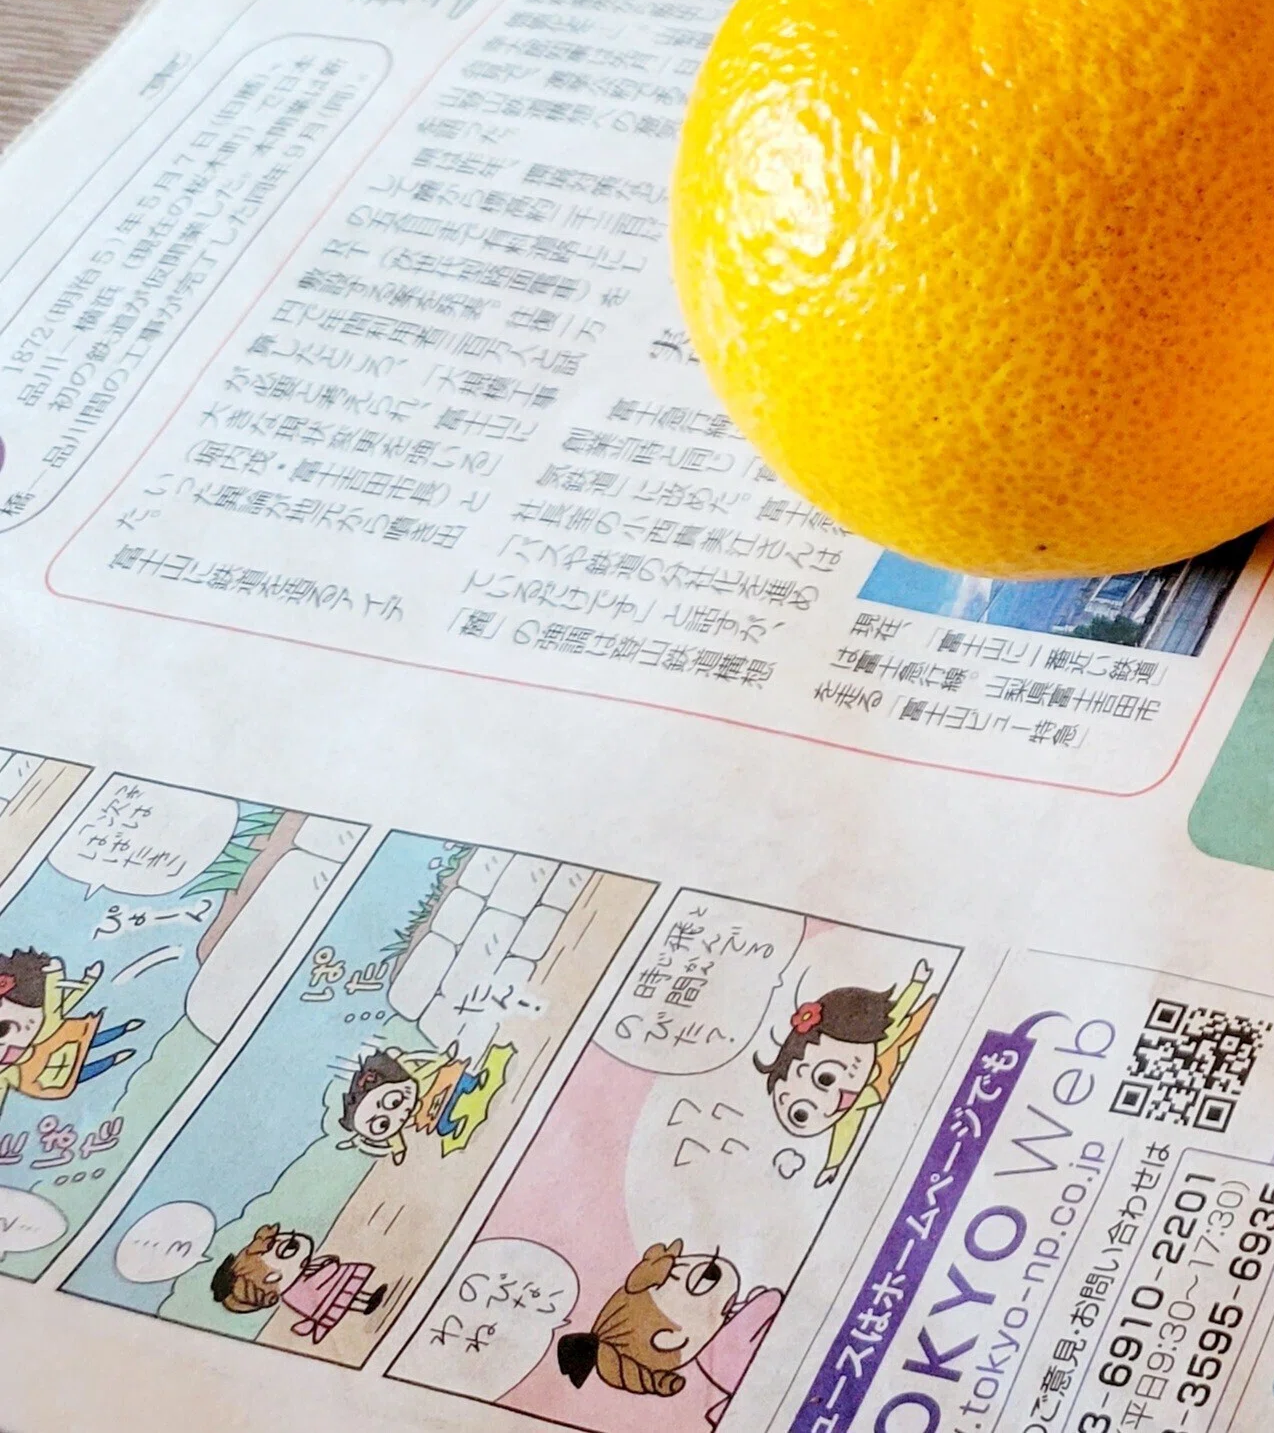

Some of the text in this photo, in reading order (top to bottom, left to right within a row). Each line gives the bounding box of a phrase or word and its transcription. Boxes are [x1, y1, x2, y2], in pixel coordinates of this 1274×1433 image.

[112, 503, 164, 534] た。
[631, 966, 708, 1008] 時間
[994, 1018, 1117, 1178] Web
